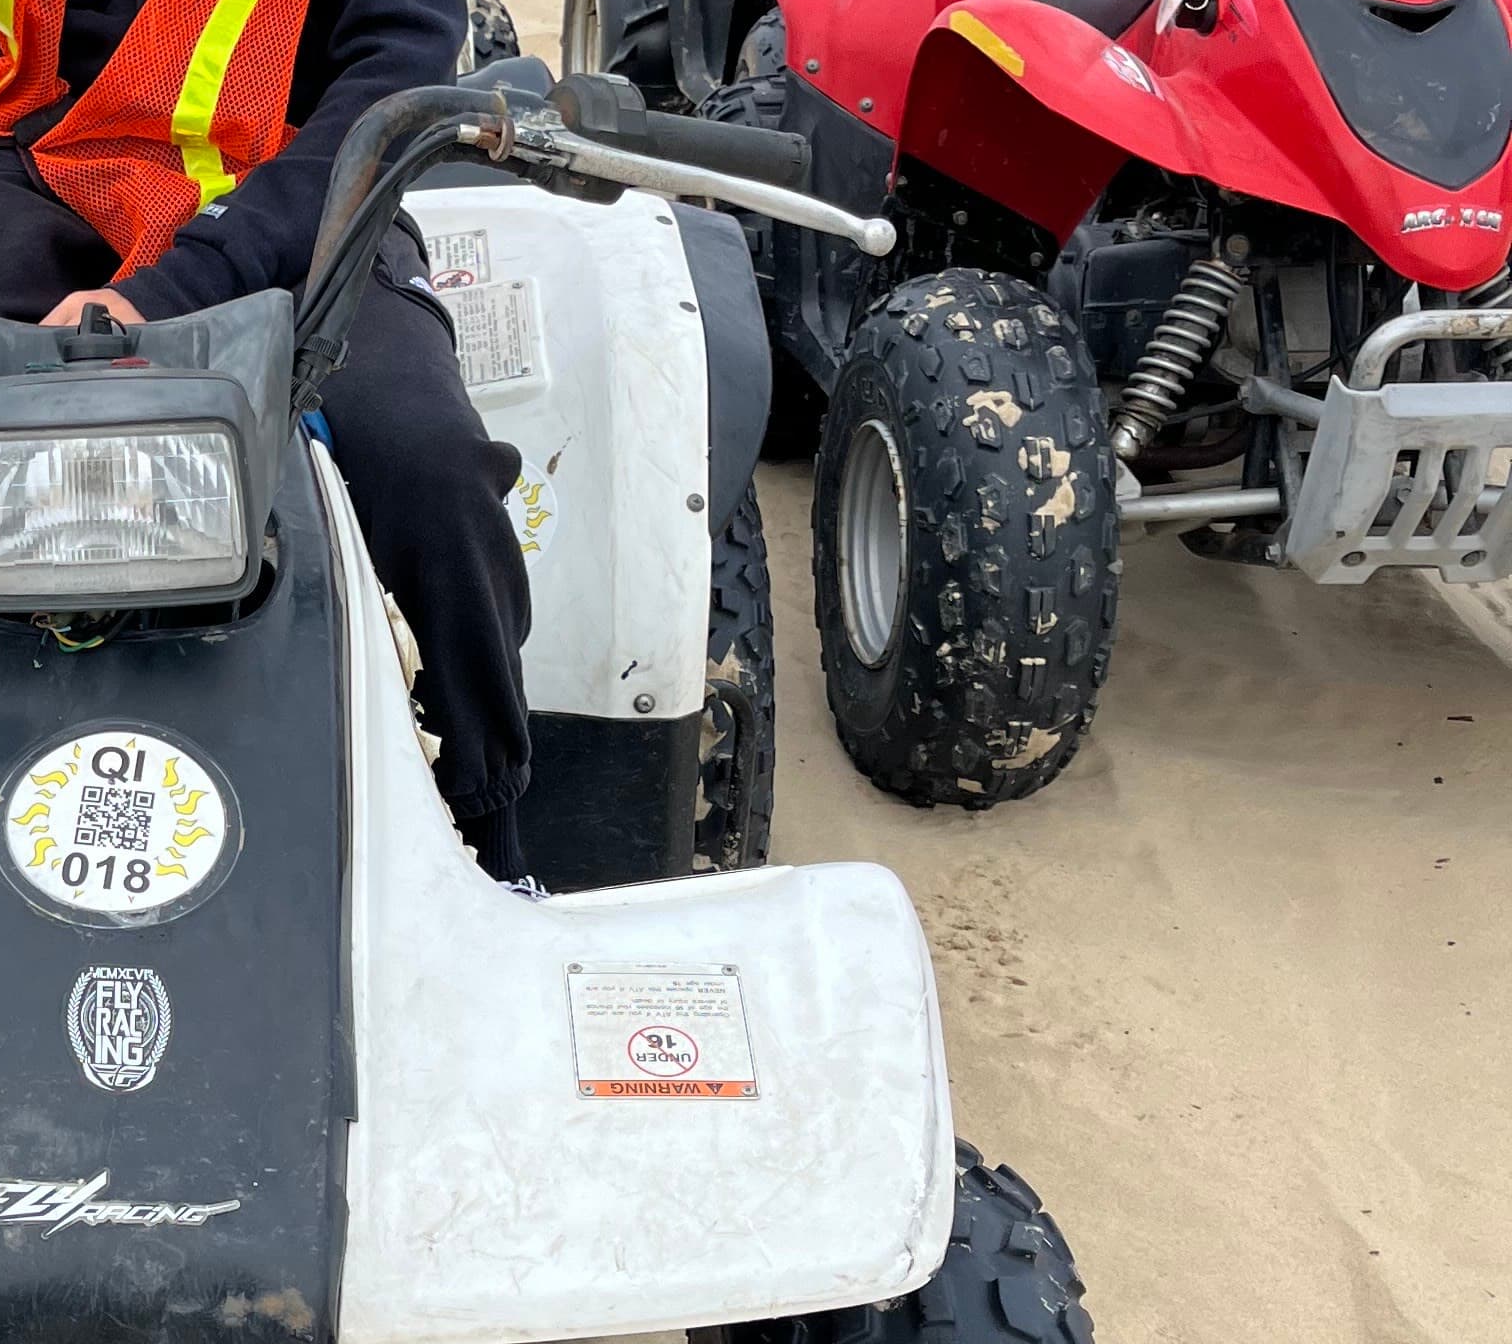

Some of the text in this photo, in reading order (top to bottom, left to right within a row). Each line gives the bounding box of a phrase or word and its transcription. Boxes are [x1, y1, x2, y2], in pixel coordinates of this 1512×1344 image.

[91, 746, 146, 783] QI
[61, 852, 151, 893] 018
[96, 980, 143, 1009] FLY
[96, 1008, 143, 1037] RAC
[95, 1036, 144, 1065] ING
[646, 1034, 677, 1049] 16
[637, 1052, 692, 1063] UNDER
[611, 1082, 701, 1094] WARNING
[76, 1203, 234, 1223] RACING
